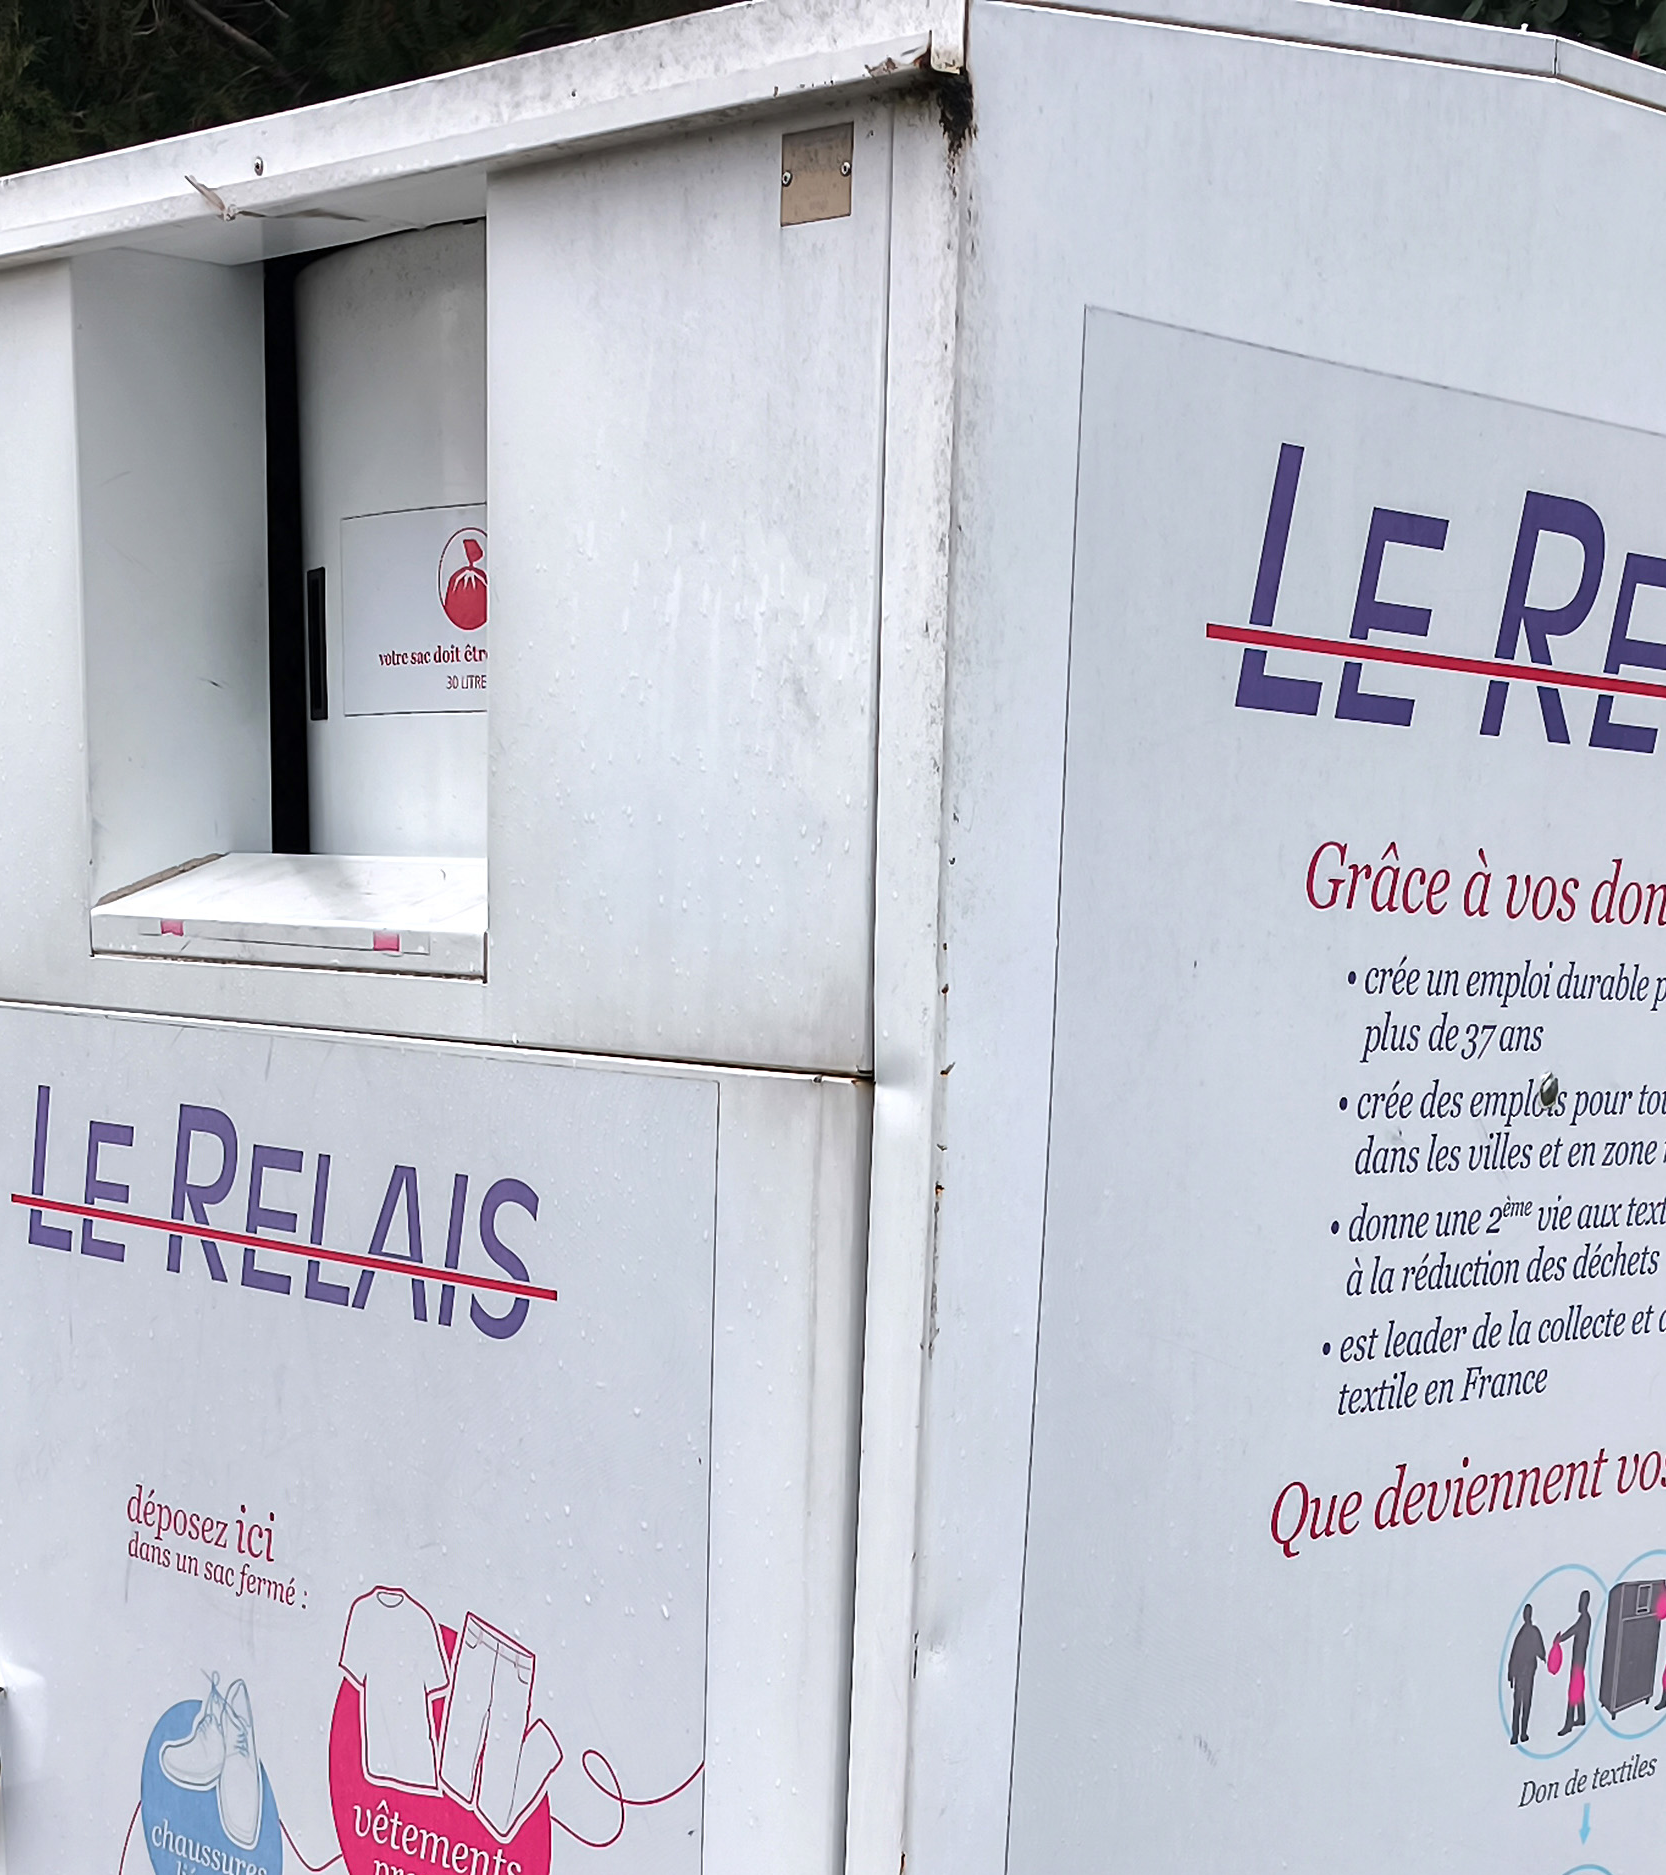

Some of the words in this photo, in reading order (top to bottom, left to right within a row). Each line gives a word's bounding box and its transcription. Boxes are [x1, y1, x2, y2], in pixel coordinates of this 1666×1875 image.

[1234, 442, 1449, 727] LE
[379, 650, 408, 666] votre
[410, 650, 430, 665] sac
[434, 644, 461, 663] doit
[464, 644, 488, 662] êtr
[446, 675, 459, 690] 30
[1305, 841, 1451, 915] Grâce
[1464, 848, 1491, 917] à
[1506, 872, 1579, 922] vos
[1364, 955, 1420, 997] crée
[1427, 969, 1460, 998] un
[1466, 960, 1554, 1008] emploi
[1556, 962, 1648, 1002] durable
[1360, 1011, 1420, 1063] plus
[1428, 1013, 1458, 1052] de
[1461, 1022, 1496, 1060] 37
[1499, 1025, 1544, 1053] ans
[1356, 1080, 1413, 1120] crée
[1420, 1079, 1464, 1119] des
[1570, 1089, 1633, 1130] pour
[1354, 1133, 1419, 1176] dans
[1427, 1133, 1461, 1173] les
[1468, 1131, 1532, 1172] villes
[1539, 1134, 1561, 1169] et
[1568, 1142, 1596, 1168] en
[1601, 1139, 1658, 1166] zone
[29, 1084, 134, 1263] LE
[166, 1103, 540, 1339] RELAIS
[1348, 1202, 1429, 1243] donne
[1435, 1211, 1481, 1239] une
[1486, 1193, 1532, 1237] 2ème
[1537, 1201, 1571, 1233] vie
[1576, 1201, 1620, 1230] aux
[1345, 1255, 1364, 1297] à
[1370, 1255, 1394, 1295] la
[1401, 1248, 1521, 1293] réduction
[1526, 1246, 1567, 1283] des
[1572, 1242, 1660, 1280] déchets
[1339, 1326, 1378, 1365] est
[1384, 1317, 1467, 1359] leader
[1472, 1309, 1502, 1353] de
[1508, 1306, 1531, 1347] la
[1537, 1302, 1625, 1344] collecte
[1631, 1300, 1653, 1335] et
[1336, 1370, 1419, 1417] textile
[1424, 1376, 1454, 1406] en
[1460, 1364, 1548, 1402] France
[127, 1484, 228, 1548] déposez
[236, 1504, 275, 1562] ici
[1269, 1481, 1363, 1558] Que
[1373, 1447, 1607, 1530] deviennent
[128, 1531, 171, 1568] dans
[176, 1552, 198, 1576] un
[204, 1560, 234, 1588] sac
[235, 1563, 295, 1606] fermé
[1518, 1780, 1560, 1808] Don
[1564, 1768, 1588, 1797] de
[1591, 1753, 1658, 1791] textiles
